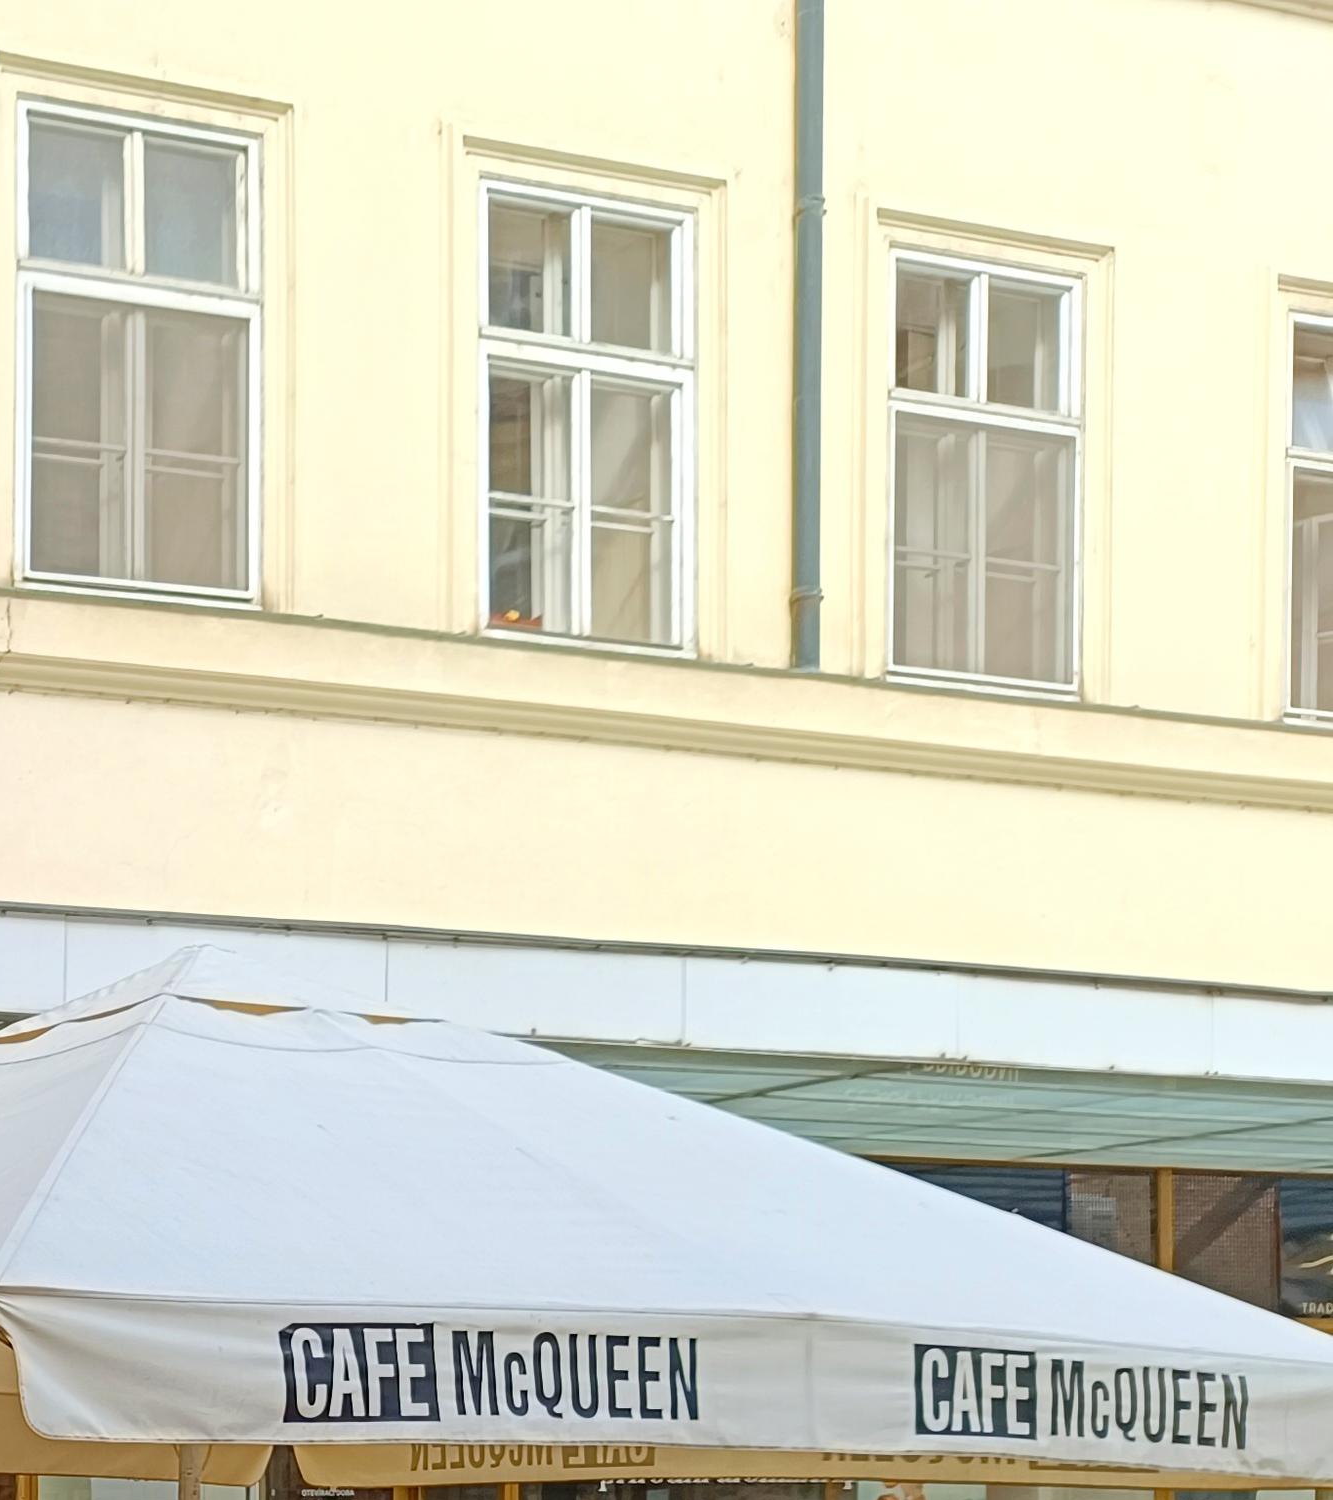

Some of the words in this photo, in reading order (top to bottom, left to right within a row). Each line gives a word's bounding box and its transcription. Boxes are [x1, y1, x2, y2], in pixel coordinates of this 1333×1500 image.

[290, 1326, 430, 1419] CAFE
[451, 1330, 699, 1420] McQUEEN
[921, 1348, 1031, 1436] CAFE
[1050, 1358, 1249, 1450] McQUEEN
